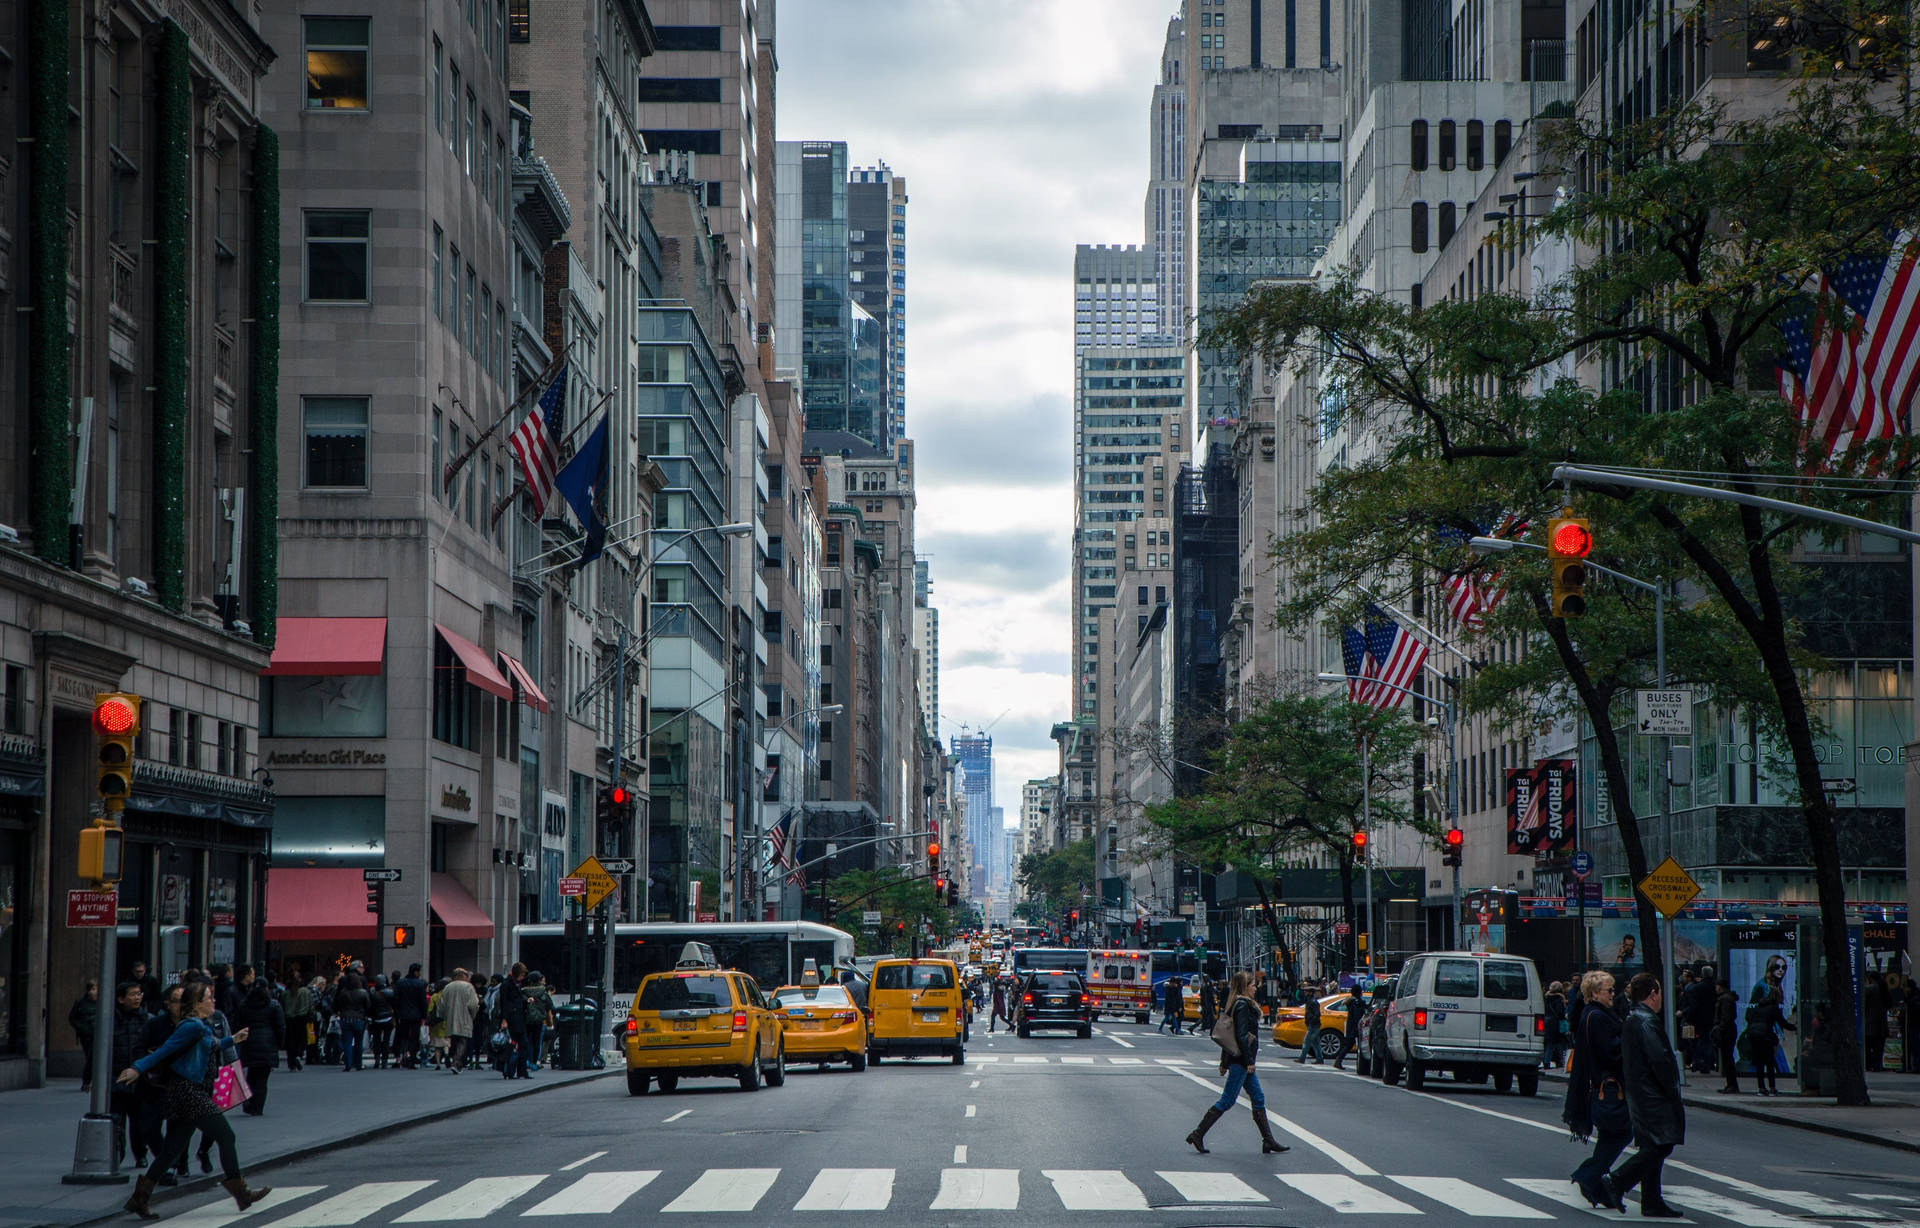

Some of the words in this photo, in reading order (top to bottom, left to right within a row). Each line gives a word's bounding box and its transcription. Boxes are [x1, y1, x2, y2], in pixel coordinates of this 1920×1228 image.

[1647, 693, 1682, 702] BUSES
[1651, 709, 1678, 718] ONLY
[267, 750, 327, 764] American
[329, 749, 351, 764] Girl
[353, 750, 386, 764] Place
[1720, 743, 1844, 763] TOPSOP
[1548, 769, 1562, 777] TGI
[1517, 778, 1530, 786] TGI
[1548, 778, 1563, 839] FRIDAYS
[1651, 875, 1688, 884] RECESSED
[71, 894, 81, 902] NO
[83, 894, 115, 902] STOPPING
[76, 904, 109, 912] ANYTIME
